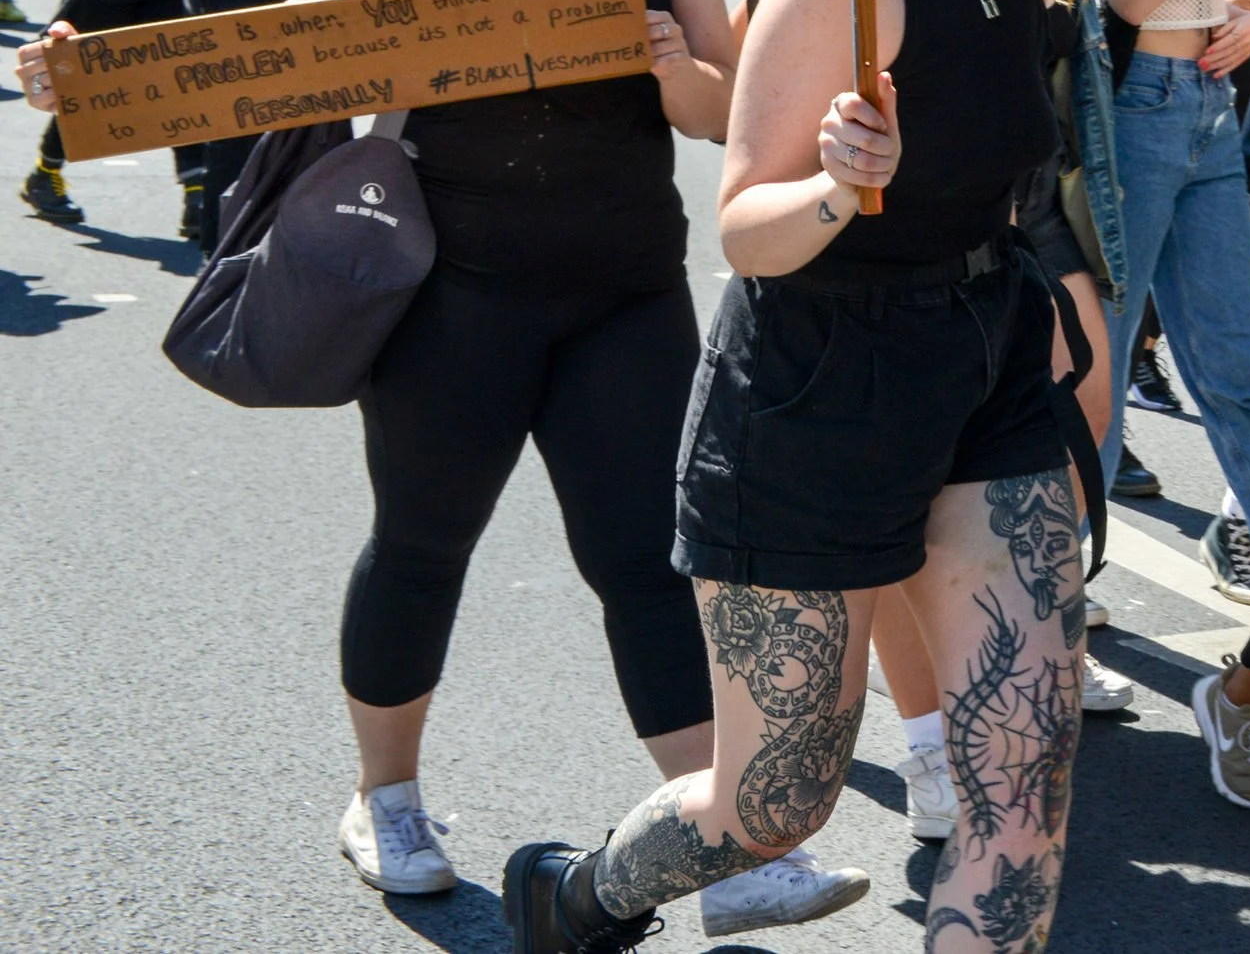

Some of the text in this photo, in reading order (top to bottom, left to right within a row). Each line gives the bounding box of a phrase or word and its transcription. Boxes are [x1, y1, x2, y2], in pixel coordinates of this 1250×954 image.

[61, 1, 631, 115] is not a PROBLEM because its not a problem
[78, 29, 218, 74] PRIVILEGE
[236, 22, 257, 41] is
[108, 122, 135, 140] to
[161, 113, 211, 138] you
[233, 77, 393, 129] PERSONALLY
